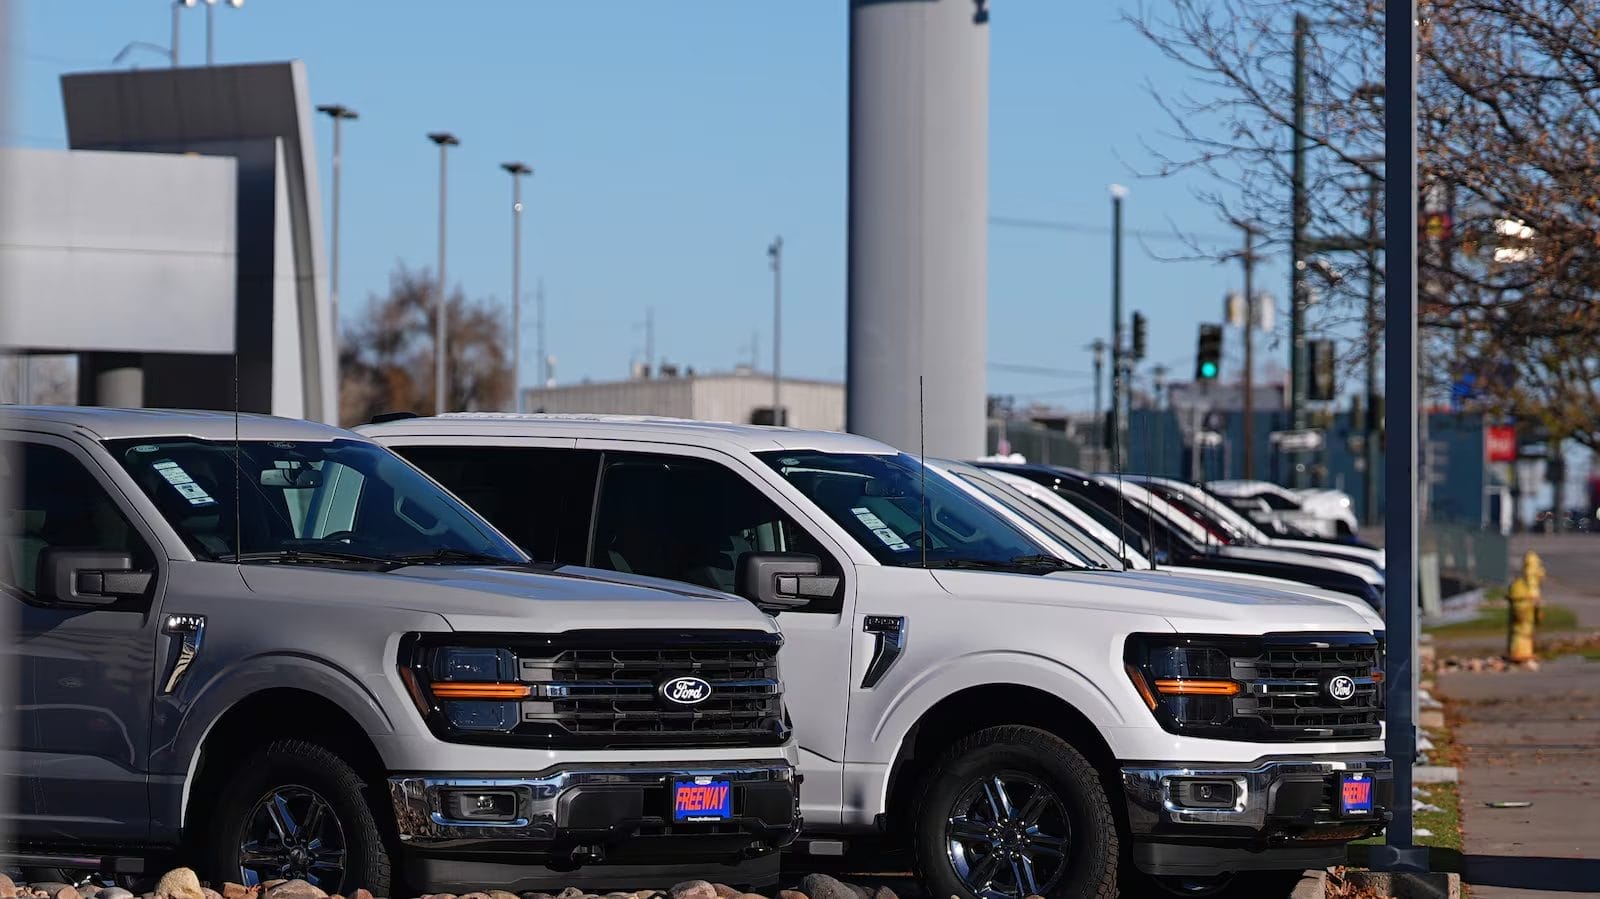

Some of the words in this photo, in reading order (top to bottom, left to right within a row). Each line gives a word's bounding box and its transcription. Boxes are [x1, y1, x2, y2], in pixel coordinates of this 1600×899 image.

[673, 680, 702, 700] Ford
[1335, 679, 1351, 696] Ford
[675, 787, 728, 811] FREEWAY
